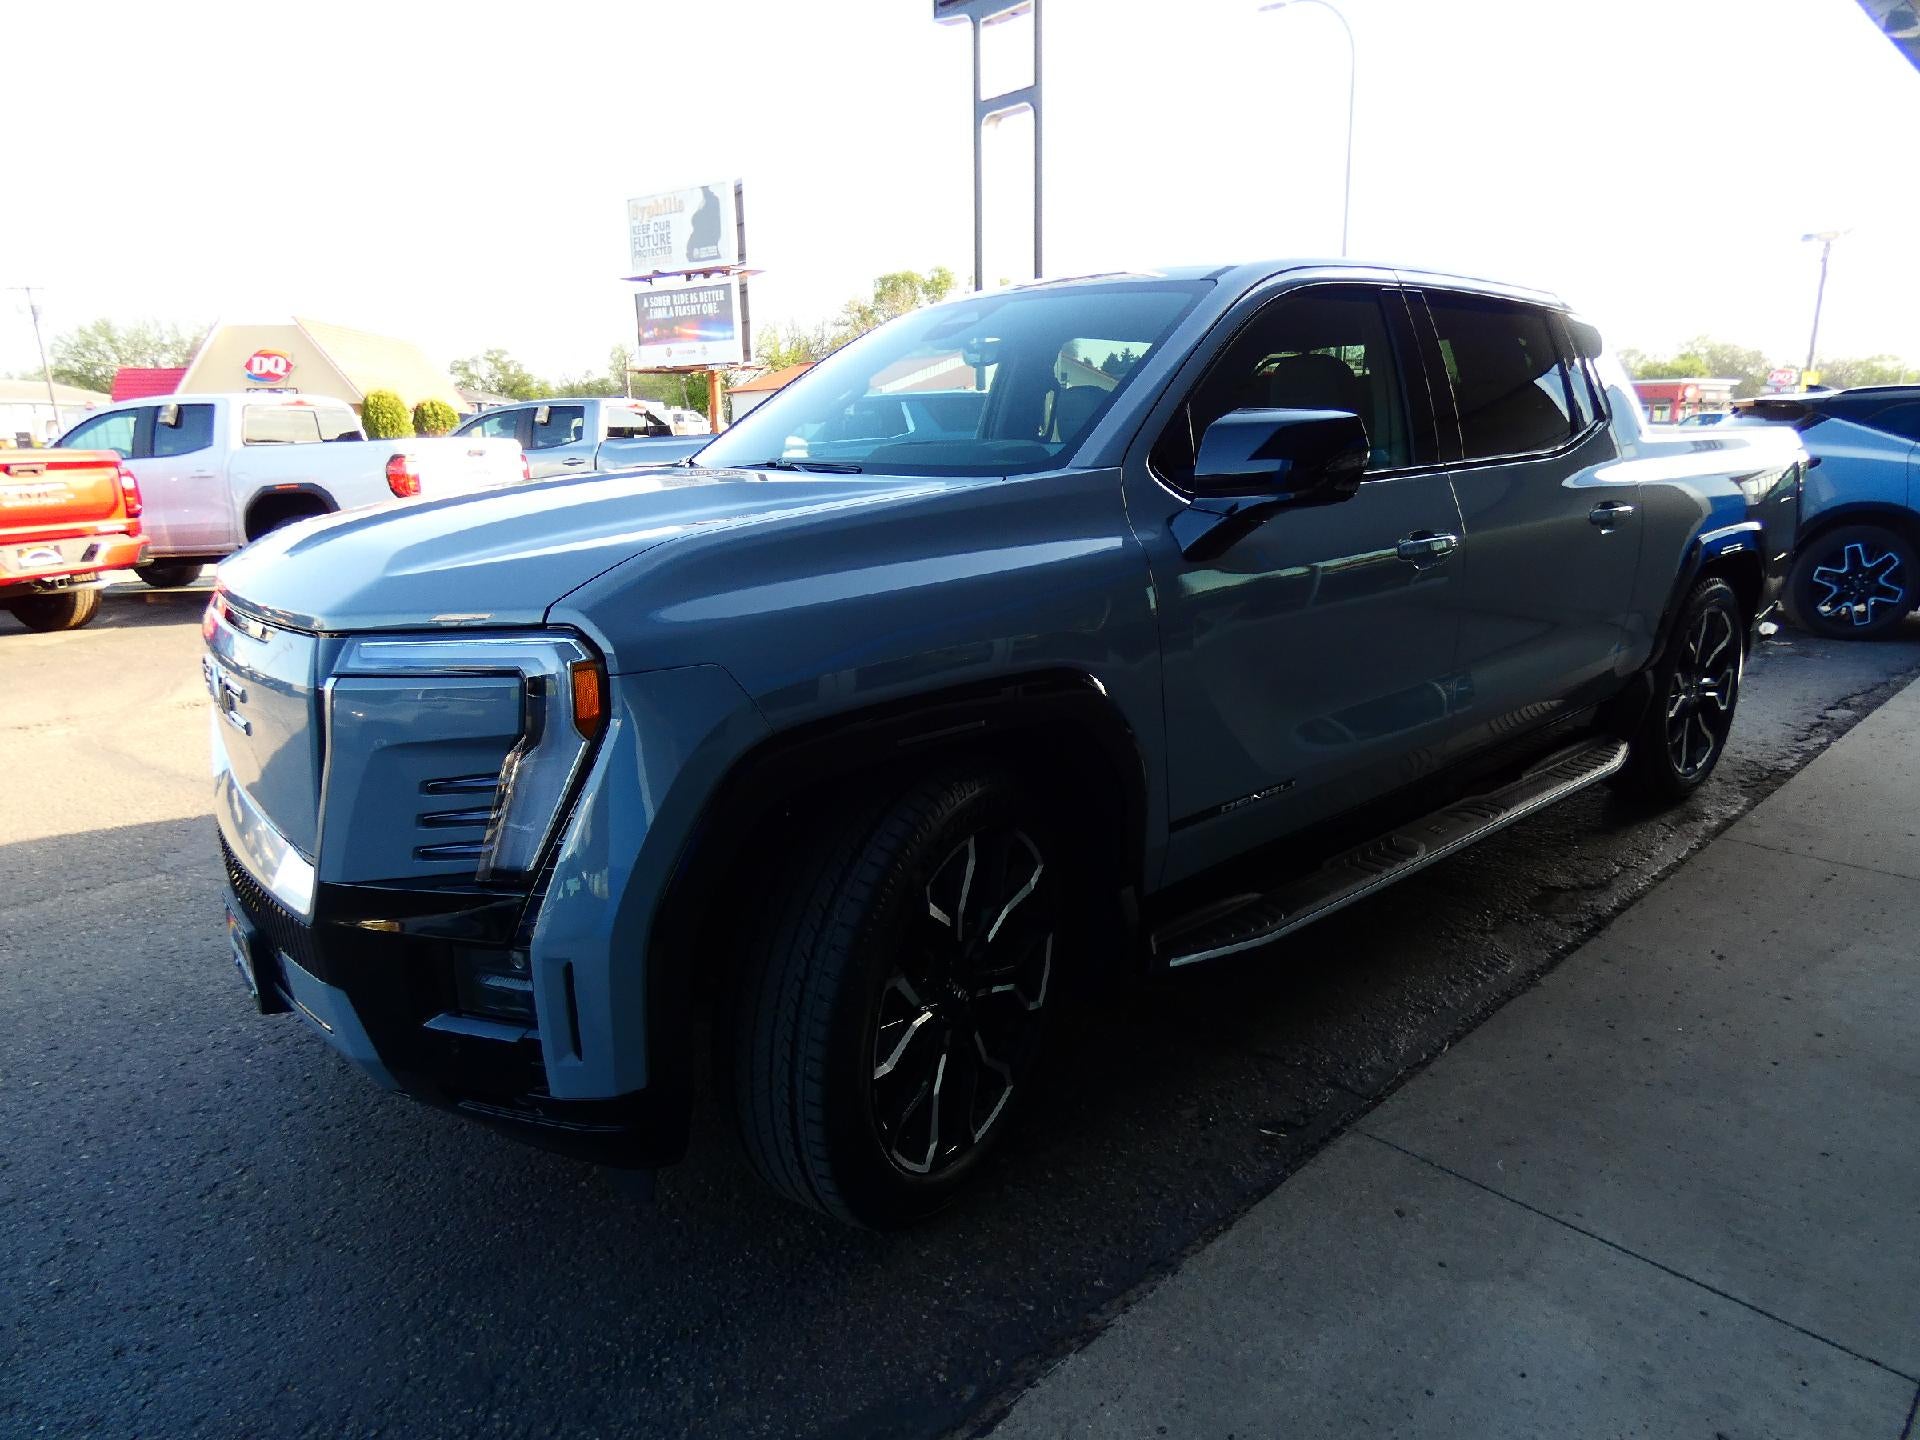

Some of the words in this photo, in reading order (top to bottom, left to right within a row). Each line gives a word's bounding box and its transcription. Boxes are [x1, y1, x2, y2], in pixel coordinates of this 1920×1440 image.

[632, 223, 651, 235] KEEP
[653, 220, 671, 232] OUR
[633, 232, 672, 249] FUTURE
[633, 246, 673, 258] PROTECTED
[643, 297, 649, 307] A
[673, 293, 689, 305] RIDE
[690, 292, 698, 303] IS
[699, 290, 725, 303] BETTER
[675, 304, 701, 317] FLASHY
[252, 356, 288, 375] DQ
